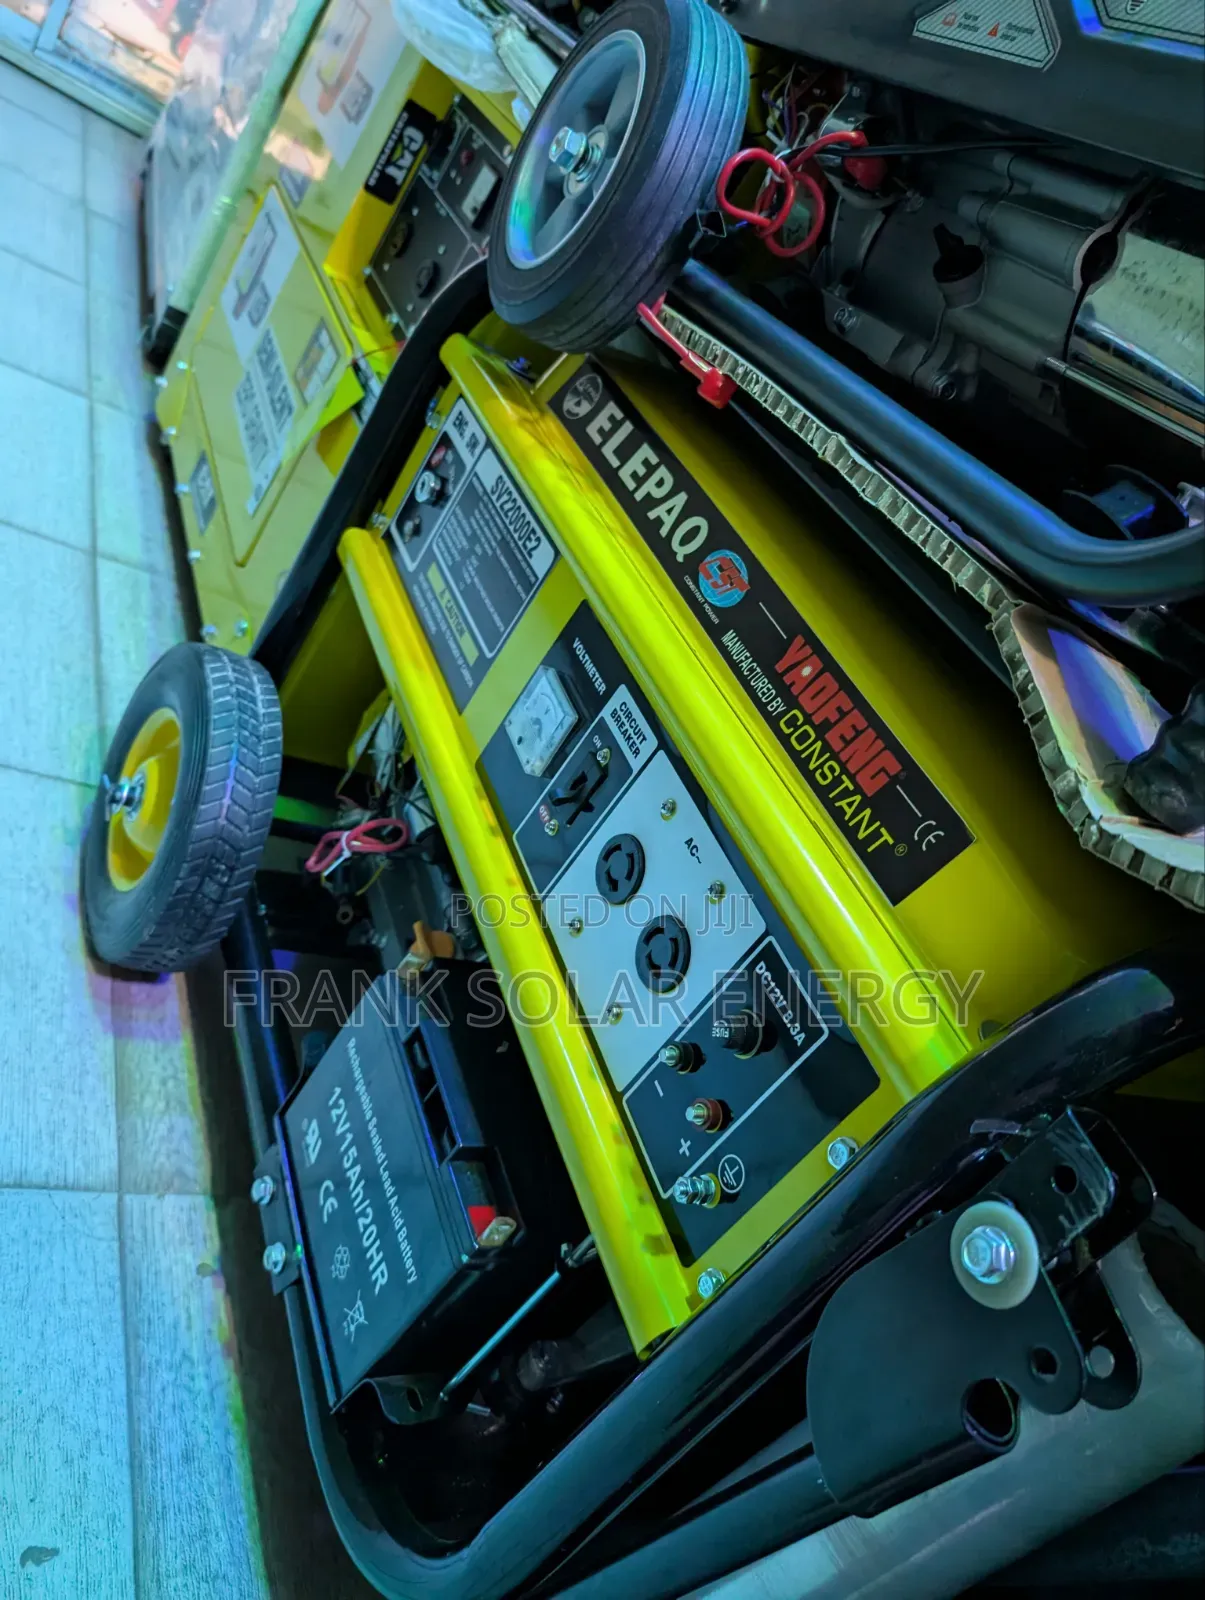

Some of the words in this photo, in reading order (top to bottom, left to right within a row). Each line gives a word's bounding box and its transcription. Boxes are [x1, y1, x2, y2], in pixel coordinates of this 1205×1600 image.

[384, 126, 424, 186] CAT
[586, 401, 708, 562] ELEPAQ
[490, 475, 542, 560] SV22000E2
[683, 575, 705, 604] CONSTANT
[702, 602, 720, 625] POWER
[572, 637, 606, 696] VOLTMETER
[721, 629, 777, 703] MANUFACTURED
[766, 698, 788, 716] BY
[592, 734, 602, 748] ON
[610, 710, 641, 760] BREAKER
[619, 701, 647, 746] CIRCUIT
[774, 634, 903, 798] YAOFENG
[540, 804, 550, 822] OFF
[754, 960, 786, 1008] DC12V
[712, 1027, 730, 1038] FUSE
[347, 1037, 372, 1121] Rechargeable
[368, 1116, 386, 1164] Sealed
[380, 1160, 396, 1198] Lead
[388, 1195, 404, 1231] Acid
[397, 1228, 418, 1284] Battery
[319, 1179, 338, 1224] CE
